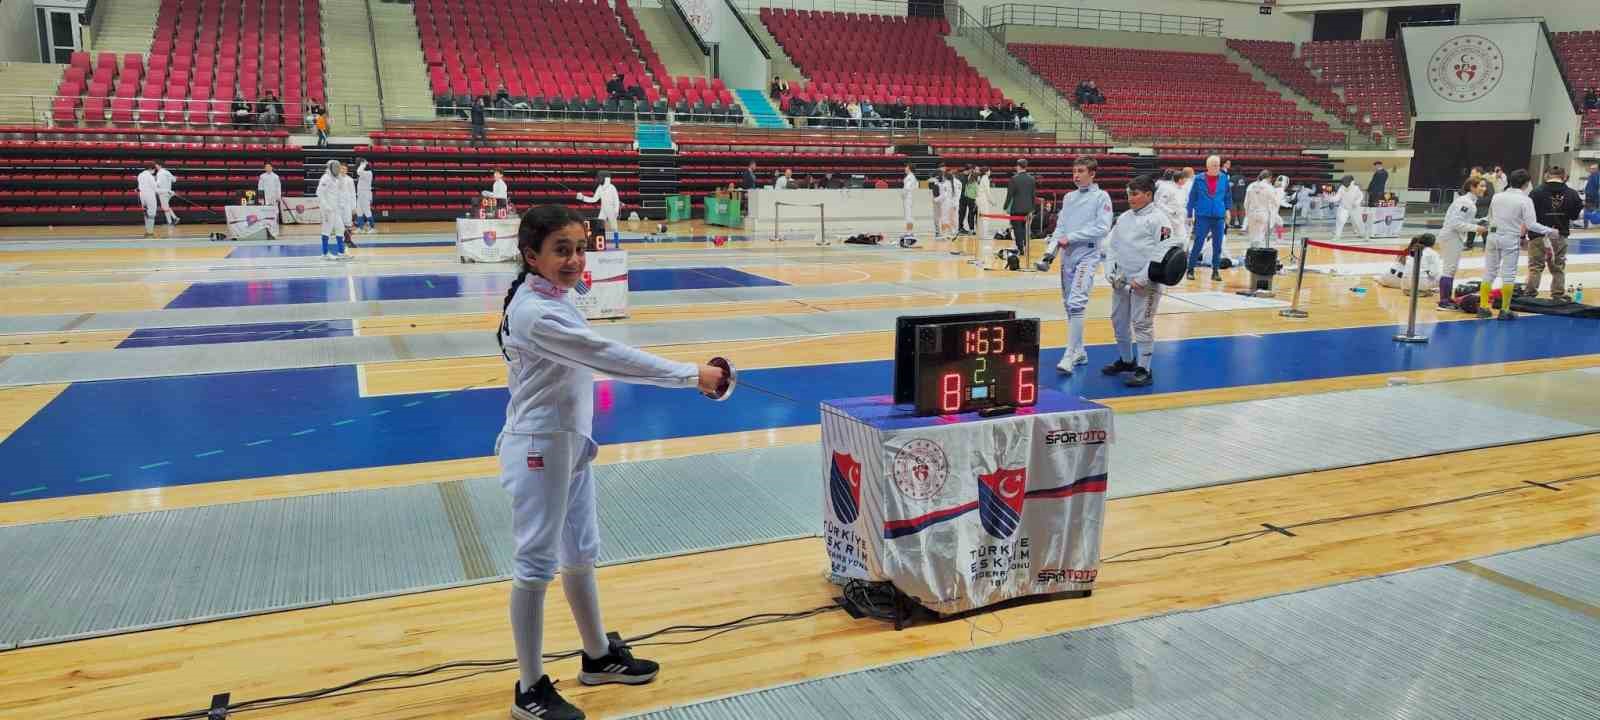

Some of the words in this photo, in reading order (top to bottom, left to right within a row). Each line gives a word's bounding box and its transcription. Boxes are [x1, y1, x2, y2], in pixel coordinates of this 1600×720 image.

[596, 235, 605, 250] 8
[965, 326, 1004, 354] 1:63
[943, 373, 961, 411] 8
[1018, 367, 1035, 404] 6
